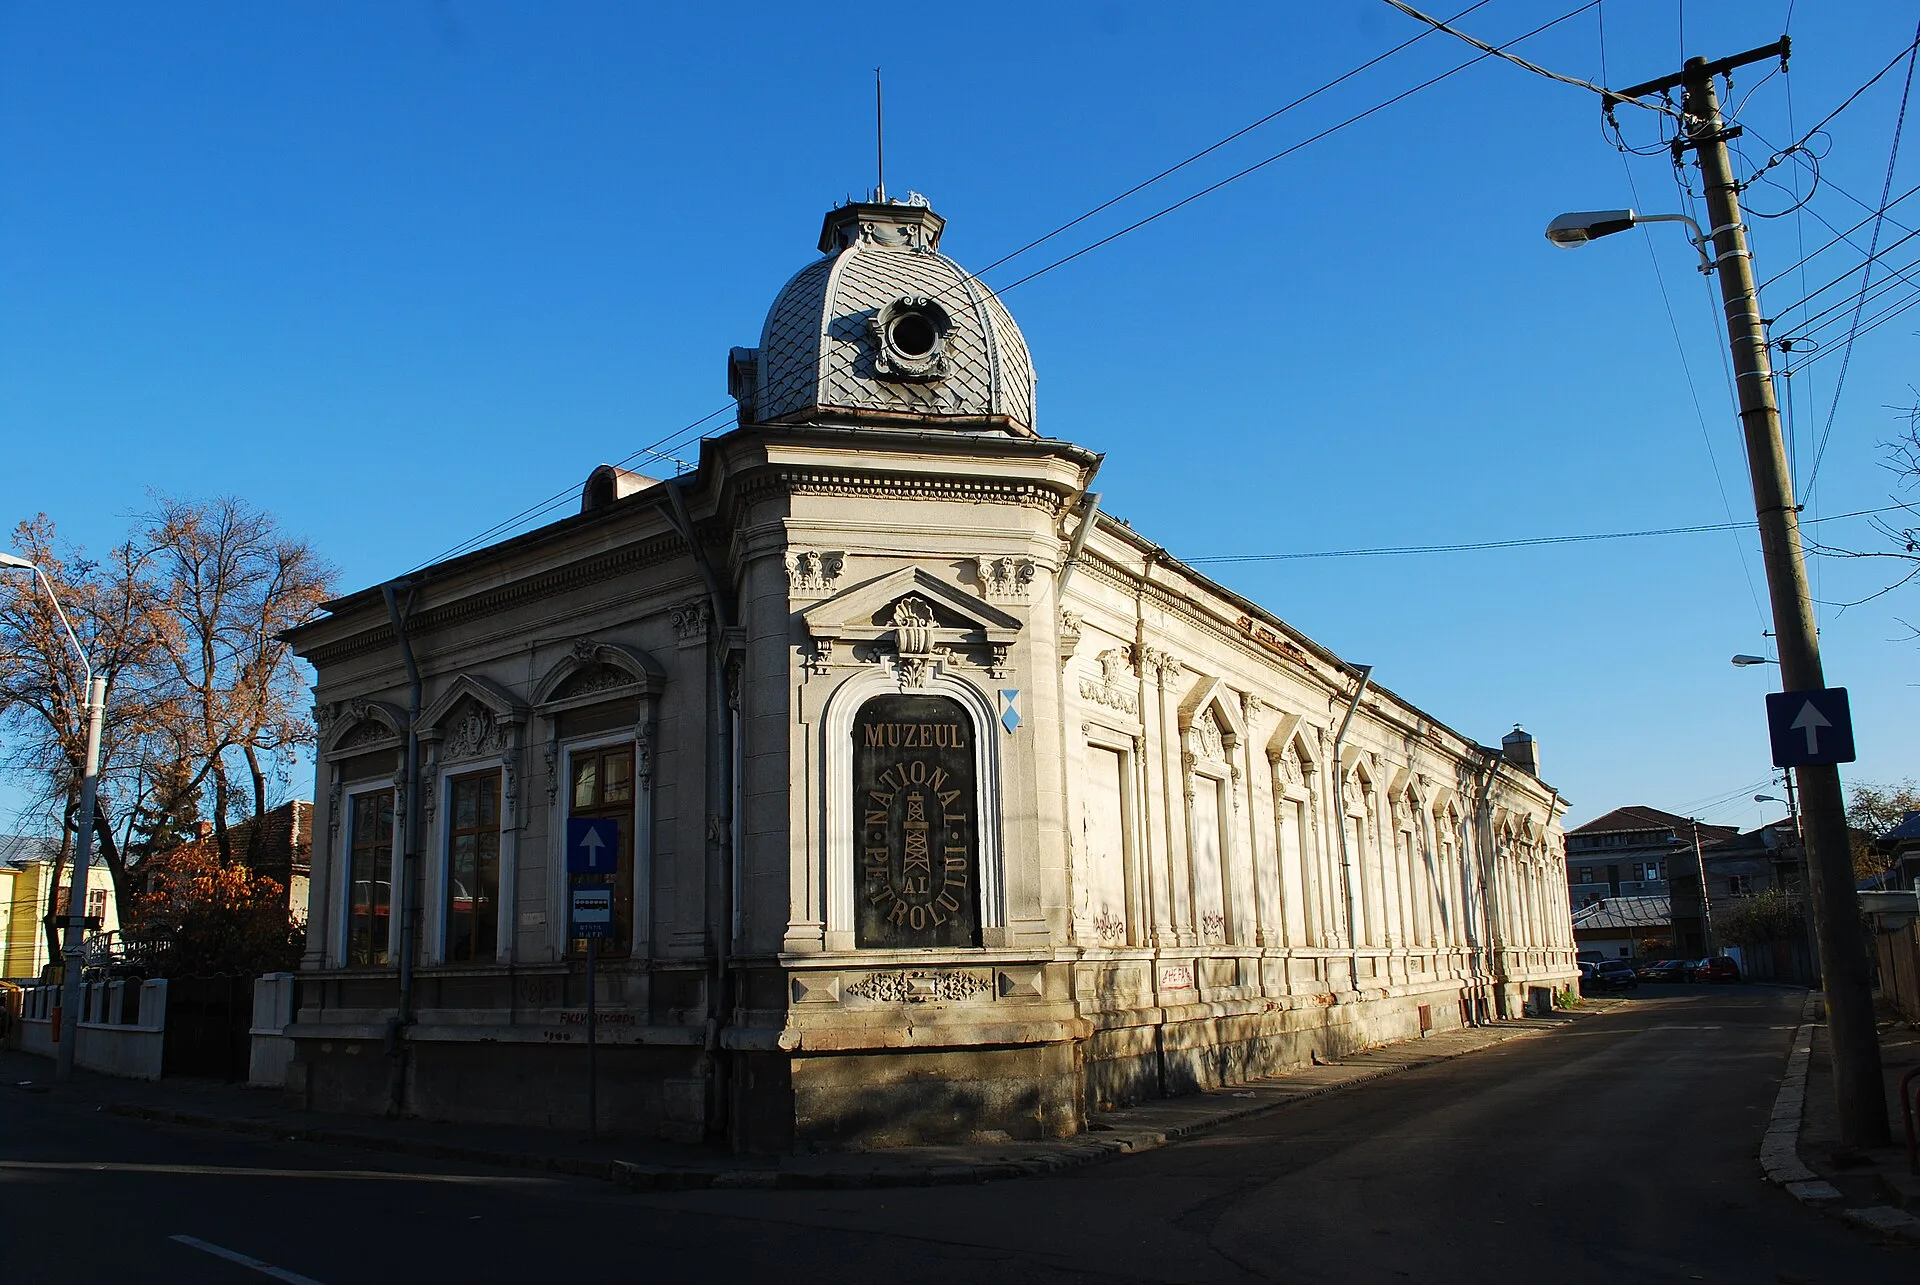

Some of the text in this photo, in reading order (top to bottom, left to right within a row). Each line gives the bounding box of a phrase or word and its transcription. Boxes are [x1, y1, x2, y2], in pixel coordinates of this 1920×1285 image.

[863, 723, 965, 748] MUZEUL
[864, 760, 967, 828] NATIONAL
[864, 845, 968, 930] PETROLULUI
[903, 876, 929, 894] AL
